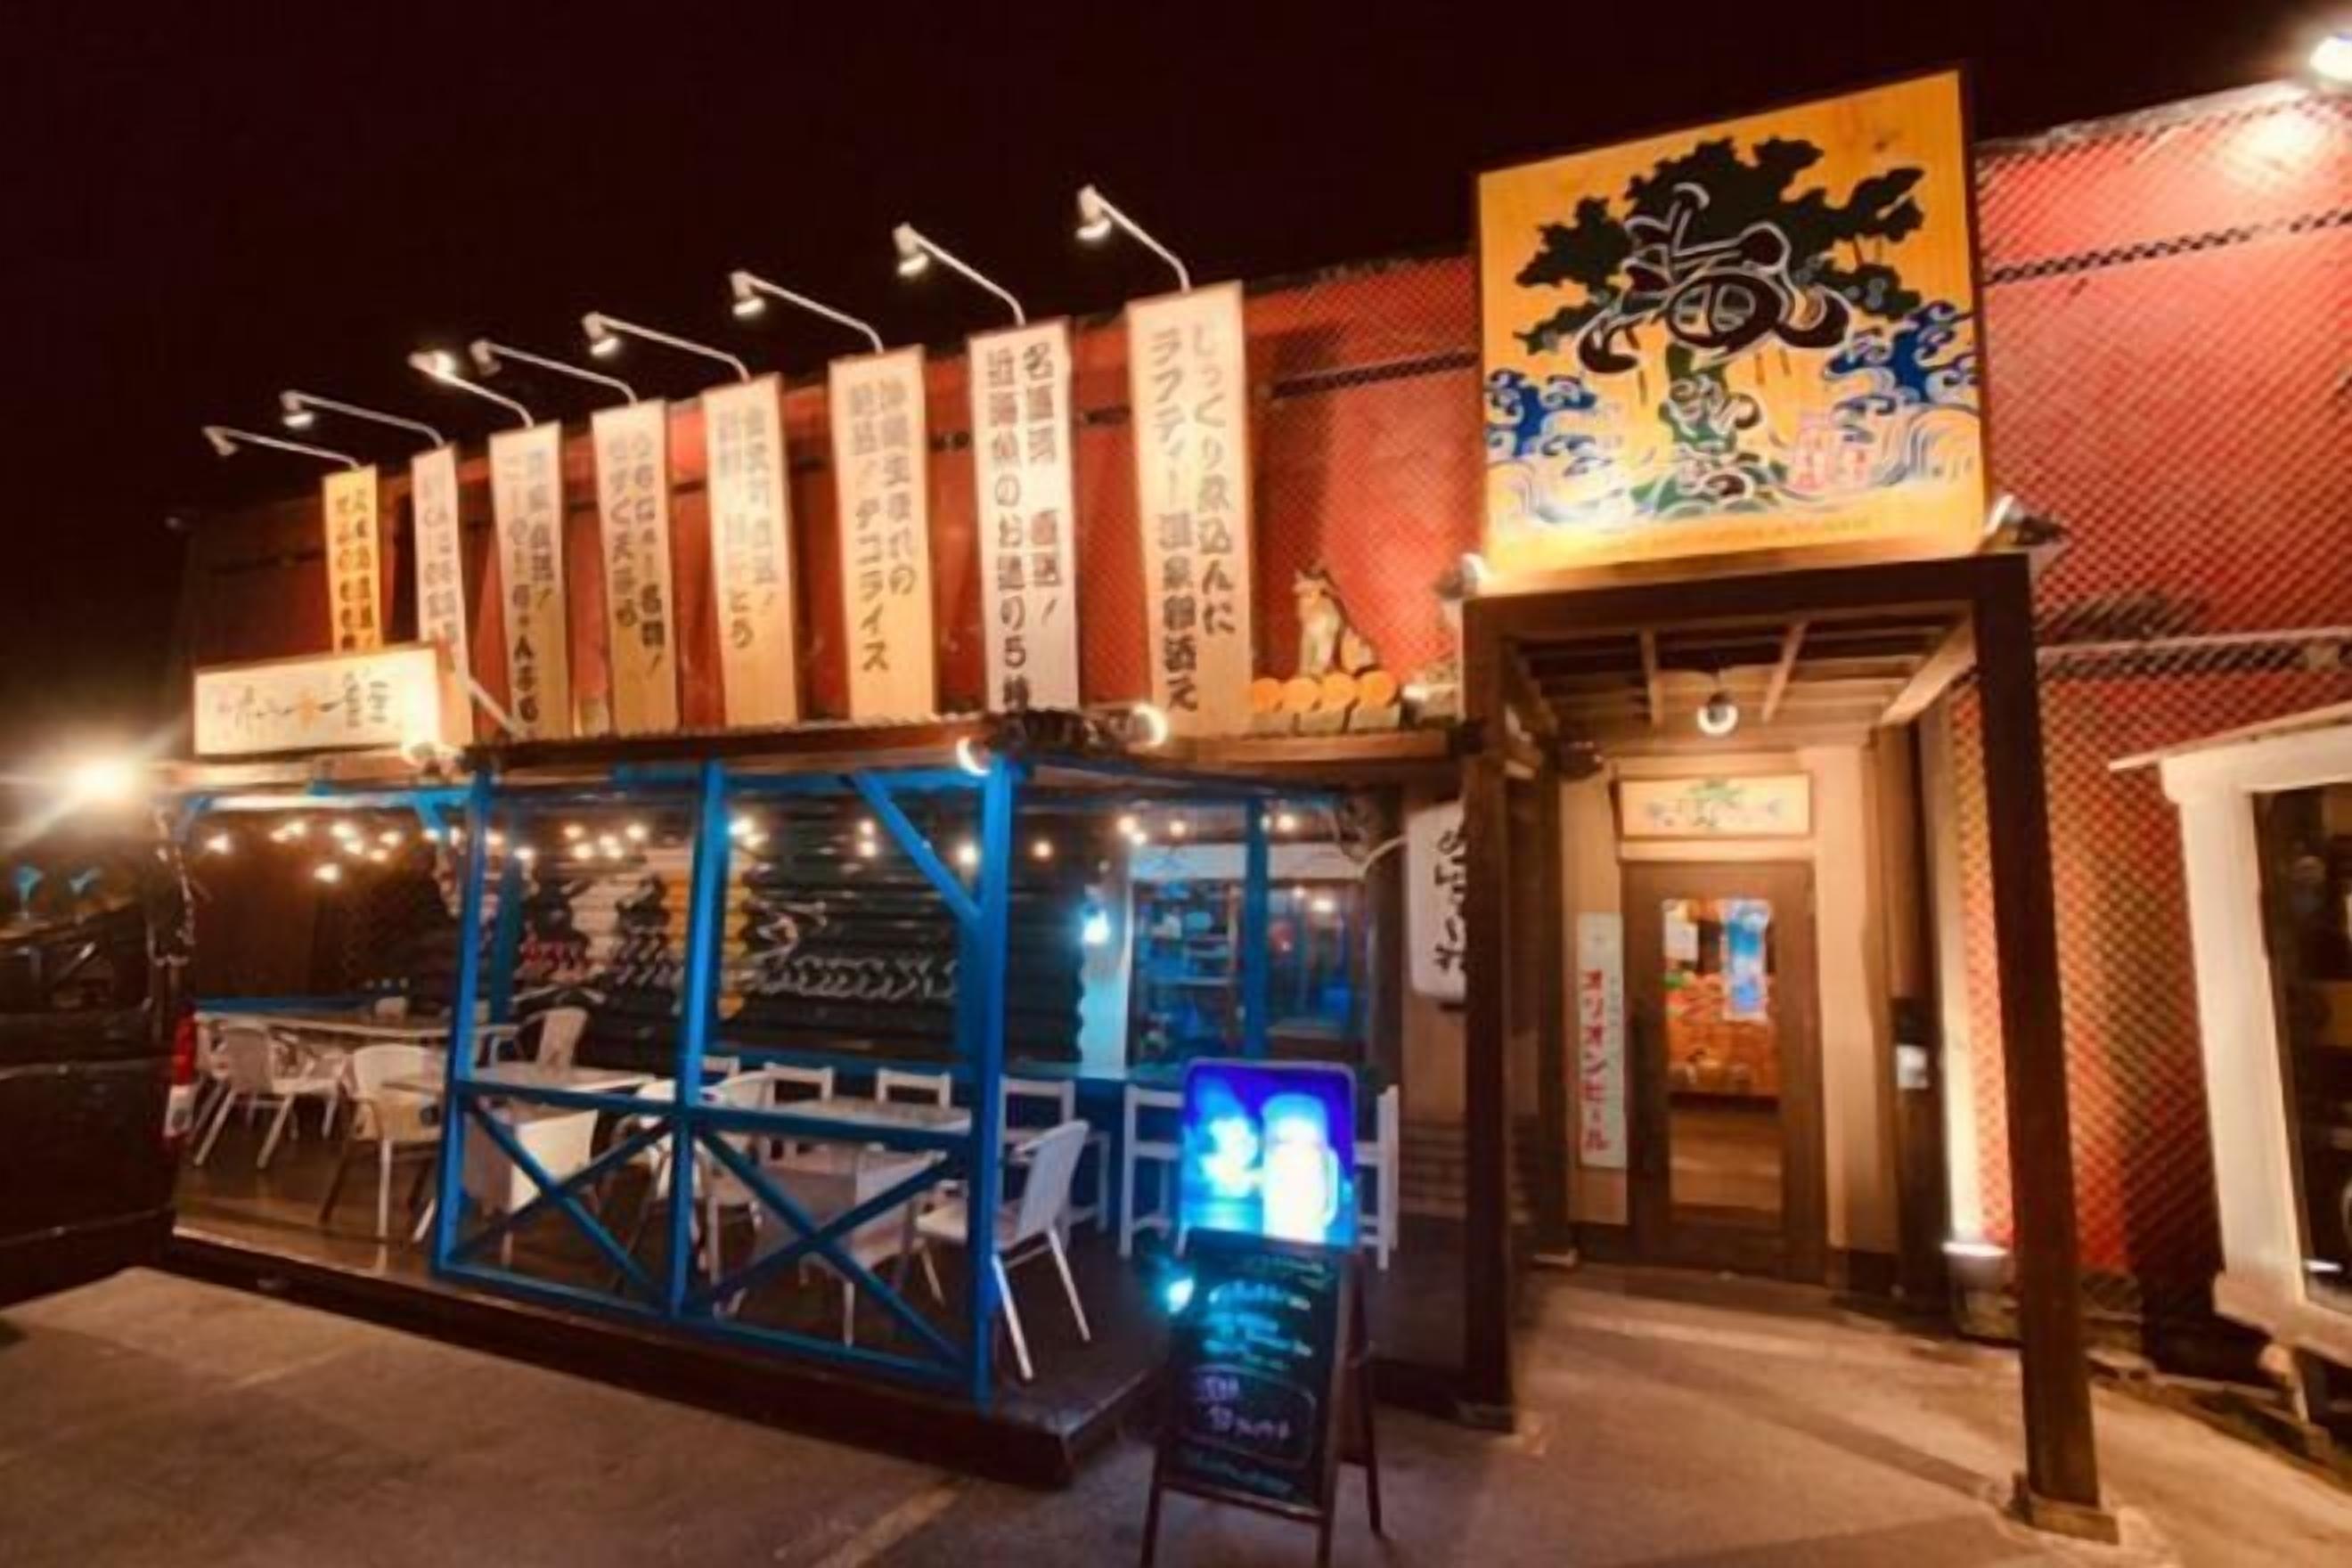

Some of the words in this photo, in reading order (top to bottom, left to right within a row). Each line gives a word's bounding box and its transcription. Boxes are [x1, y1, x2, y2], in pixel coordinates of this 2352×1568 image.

[1581, 969, 1609, 1152] オリオンビール
